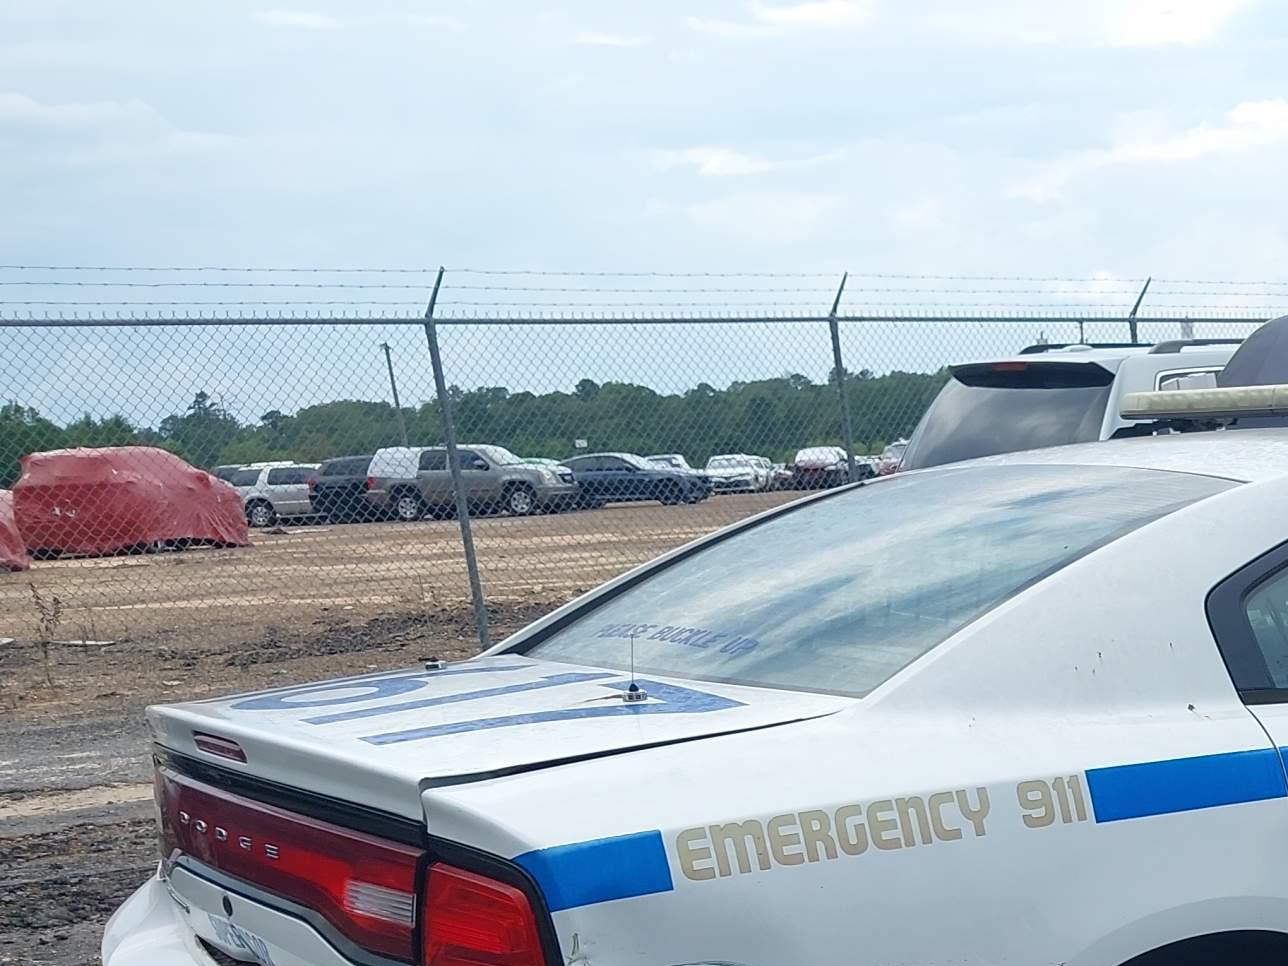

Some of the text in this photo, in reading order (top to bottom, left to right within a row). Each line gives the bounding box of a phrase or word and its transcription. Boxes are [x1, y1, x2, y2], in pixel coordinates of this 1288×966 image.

[647, 625, 727, 649] BUCKLE
[719, 636, 759, 655] UP
[178, 809, 280, 860] DODGE
[676, 774, 1088, 882] EMERGENCY 911
